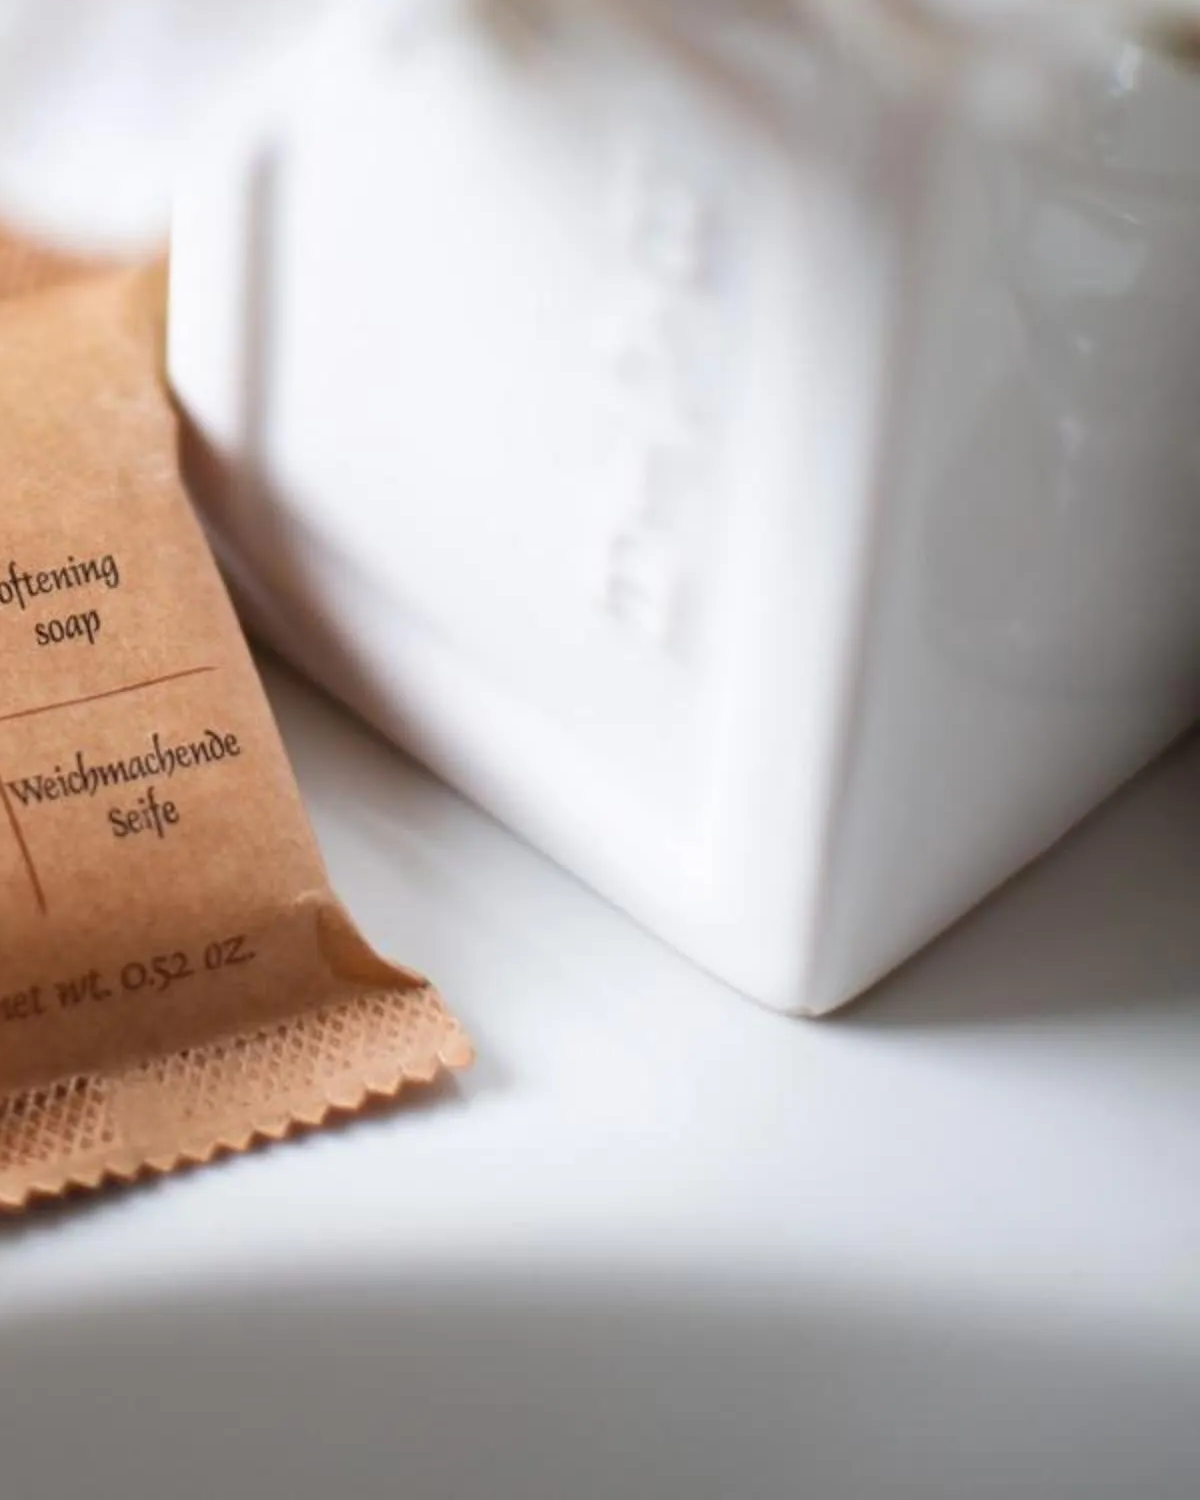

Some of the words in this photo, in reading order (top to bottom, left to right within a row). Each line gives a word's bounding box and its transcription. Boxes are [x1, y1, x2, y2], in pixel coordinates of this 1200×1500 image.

[34, 609, 101, 646] soap
[6, 729, 241, 806] Weichmachende
[107, 785, 180, 839] Seife
[53, 967, 113, 1007] wt.
[119, 950, 196, 993] 0.52
